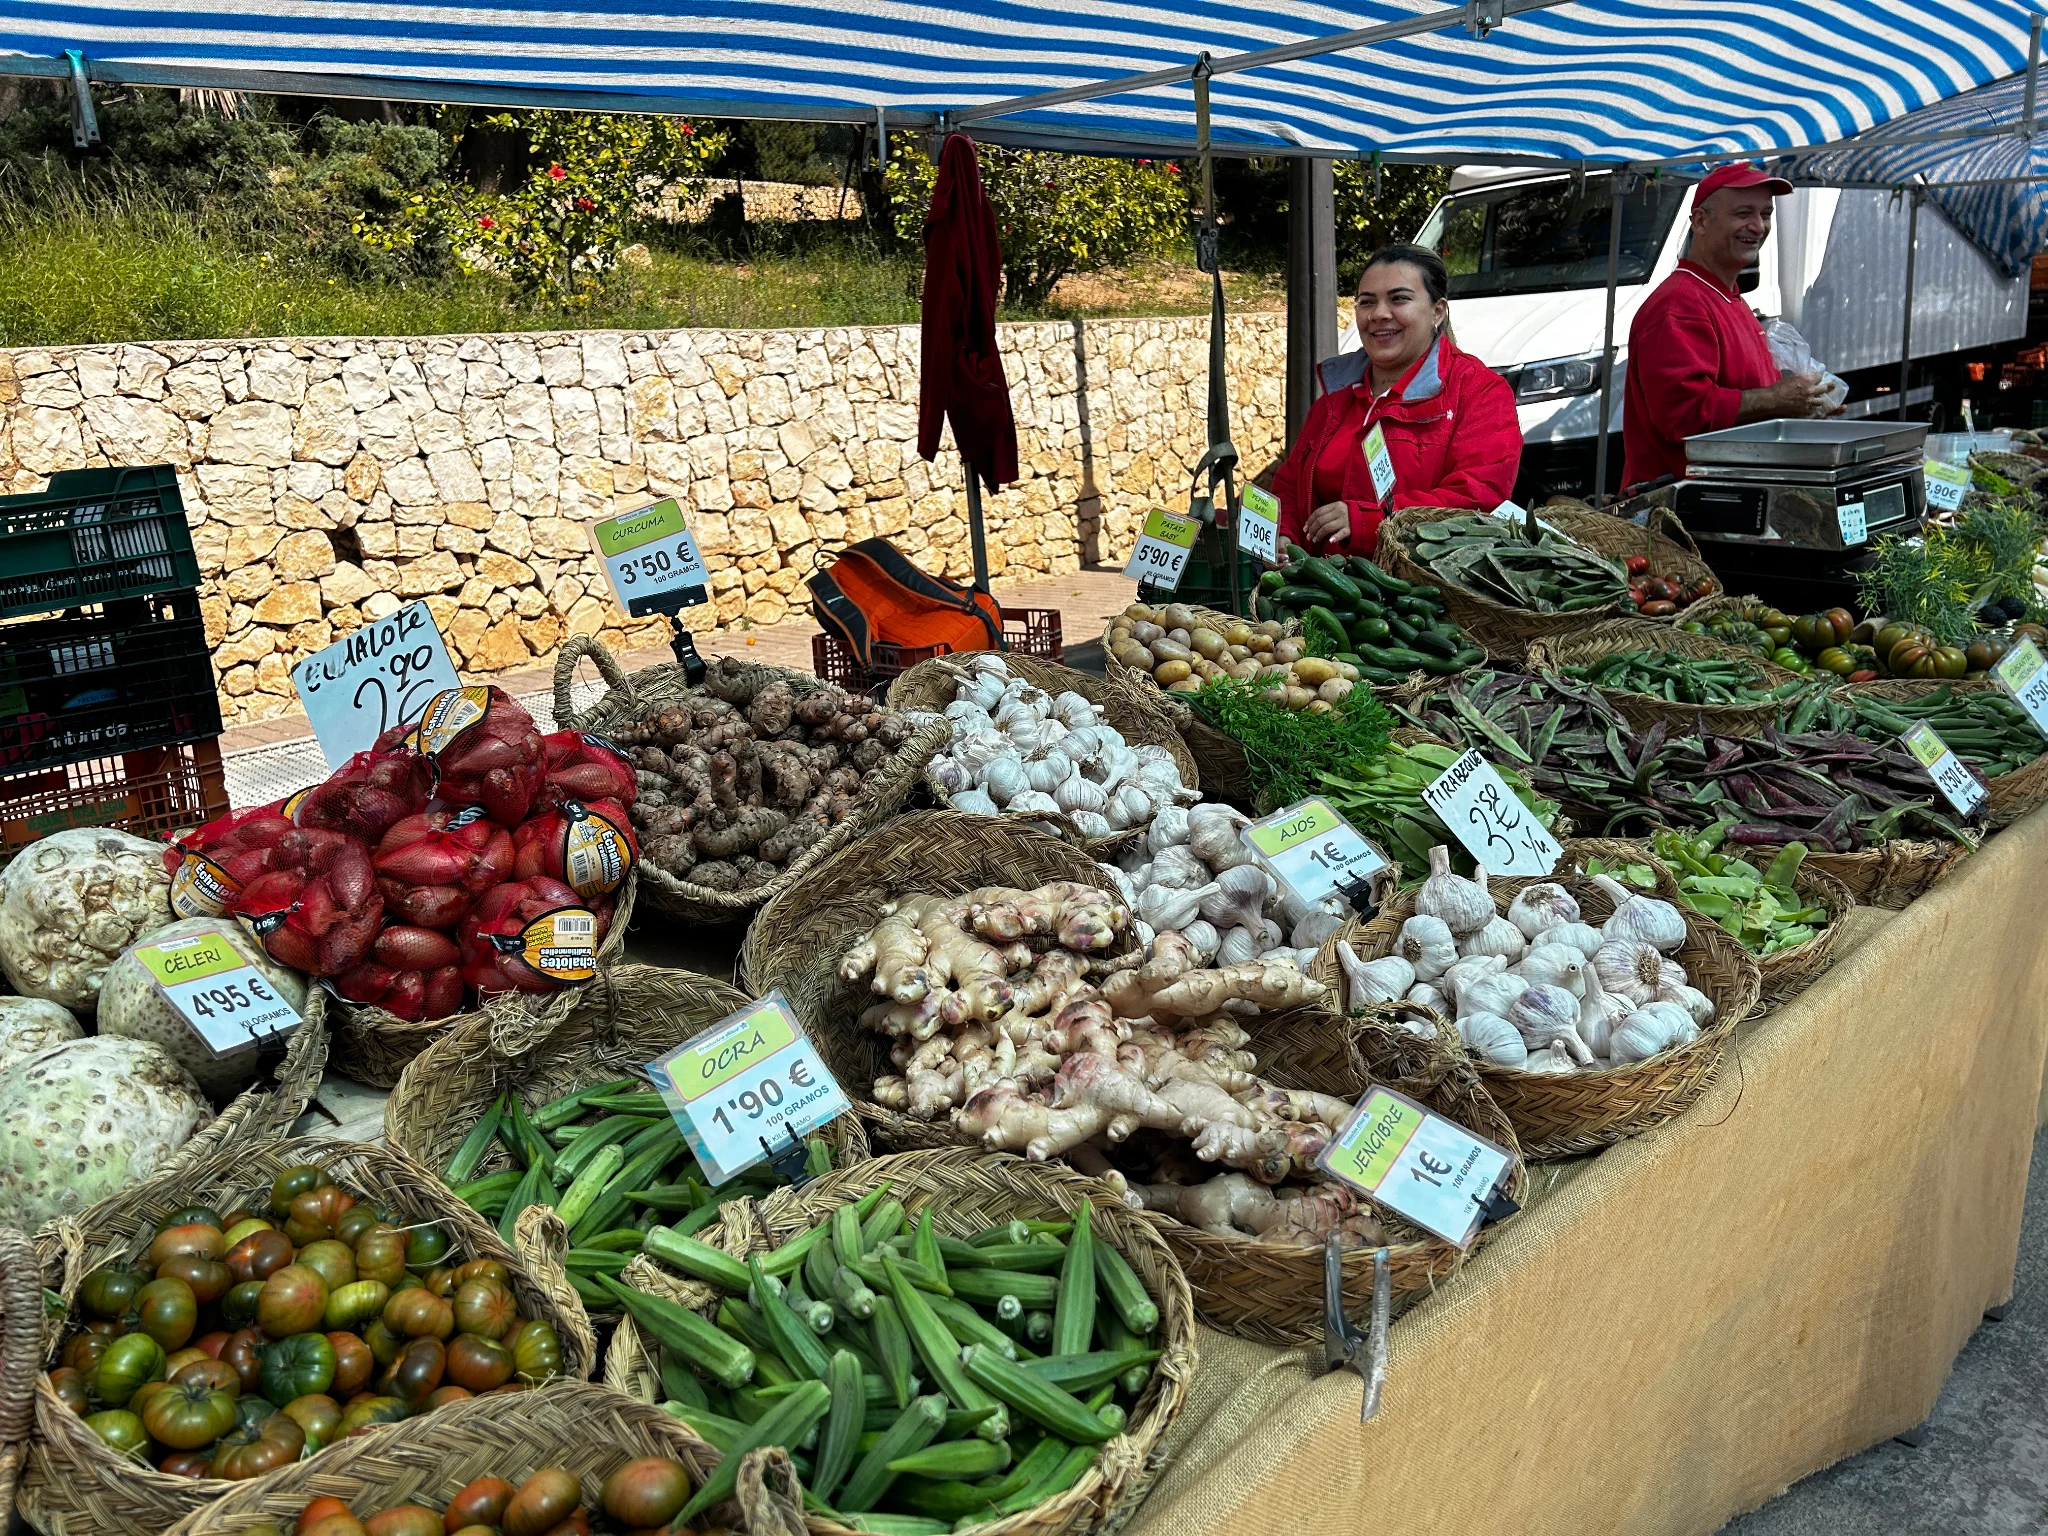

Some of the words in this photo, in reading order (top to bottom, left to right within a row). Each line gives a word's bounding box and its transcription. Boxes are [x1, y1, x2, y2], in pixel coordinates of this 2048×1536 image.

[612, 515, 665, 541] CURCUMA
[1159, 530, 1179, 541] BABY
[1160, 520, 1187, 534] PATATA
[1244, 518, 1272, 546] 7,90€
[619, 550, 671, 585] 3'50
[676, 541, 694, 563] €
[1138, 544, 1170, 568] 5'90
[1171, 554, 1184, 572] €
[653, 574, 667, 585] 100
[667, 563, 700, 579] GRAMOS
[1426, 749, 1482, 809] TIRABEQUE
[1280, 816, 1316, 841] AJOS
[600, 829, 622, 882] Échalotes
[1309, 841, 1347, 869] 1€
[1332, 862, 1345, 872] 100
[1344, 849, 1372, 866] GRAMOS
[256, 922, 262, 930] g
[261, 916, 276, 929] 250
[164, 947, 222, 974] CÉLERI
[540, 948, 592, 956] traditionnelles
[540, 956, 597, 973] Échalotes
[192, 983, 251, 1018] 4'95
[247, 978, 274, 1001] €
[240, 1007, 291, 1029] KILOGRAMOS
[701, 1030, 766, 1079] OCRA
[712, 1078, 784, 1135] 1'90
[788, 1058, 816, 1087] €
[766, 1112, 784, 1128] 100
[785, 1085, 830, 1116] GRAMOS
[772, 1115, 812, 1144] KILORAMO
[1352, 1104, 1403, 1175] JENGIBRE
[1410, 1150, 1453, 1188] 1€
[1452, 1173, 1464, 1189] 100
[1461, 1145, 1482, 1177] GRAMOS
